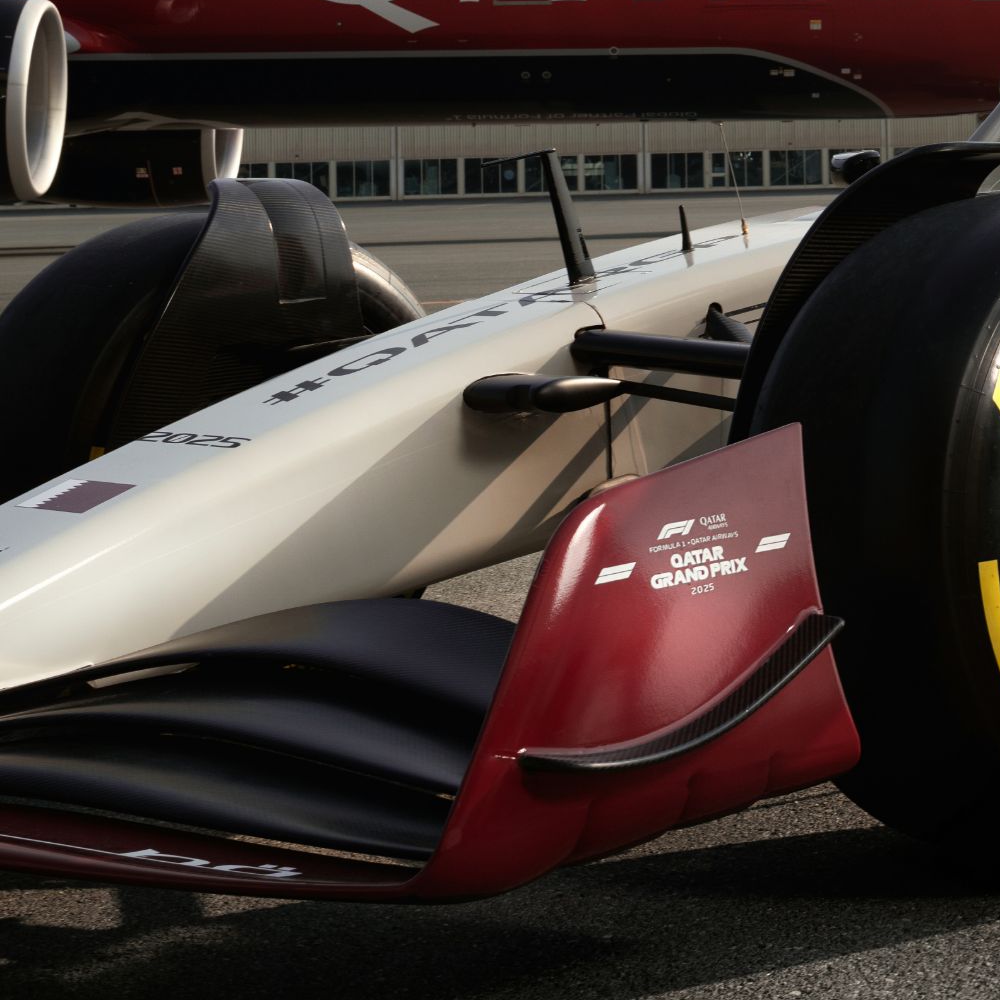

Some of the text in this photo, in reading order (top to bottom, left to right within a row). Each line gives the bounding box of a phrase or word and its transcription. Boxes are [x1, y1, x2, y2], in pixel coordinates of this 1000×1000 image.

[138, 431, 252, 449] 2025
[657, 519, 695, 540] F1
[700, 513, 726, 526] QATAR
[649, 541, 681, 553] FORMULA
[712, 531, 739, 541] AIRWAYS
[670, 546, 724, 568] QATAR
[650, 557, 749, 590] GRAND PRIX
[691, 583, 715, 595] 2025
